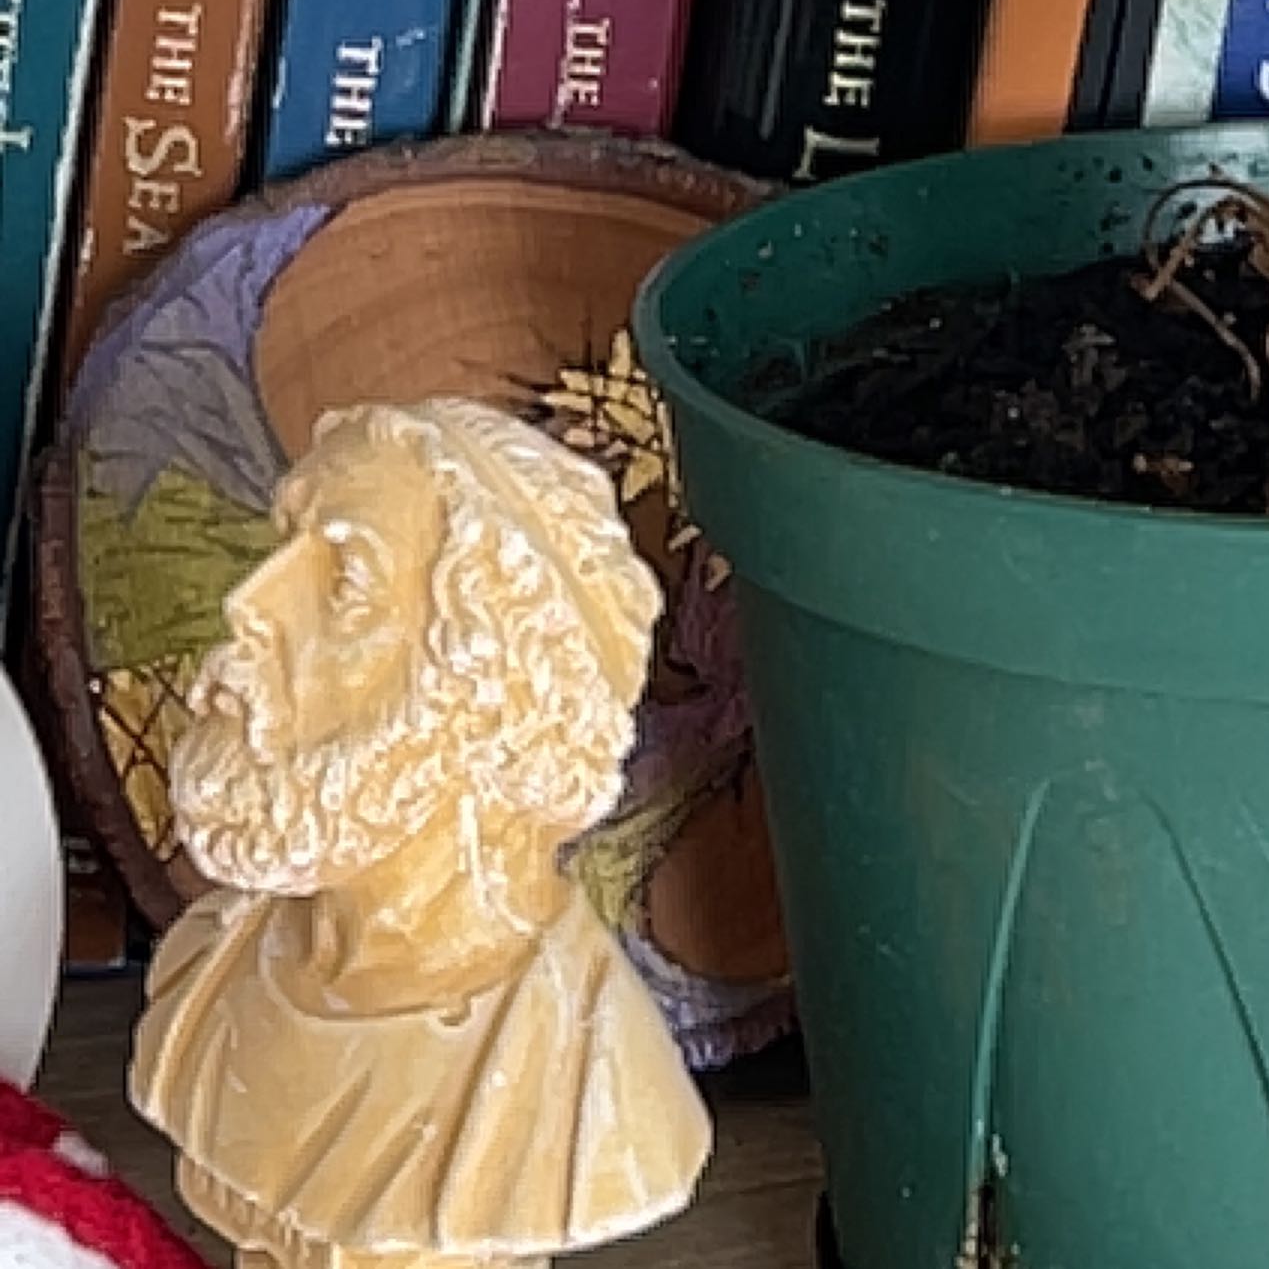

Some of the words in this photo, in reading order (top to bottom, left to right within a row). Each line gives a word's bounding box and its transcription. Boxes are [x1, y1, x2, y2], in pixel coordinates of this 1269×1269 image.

[145, 3, 204, 106] THE
[325, 36, 384, 148] THE
[556, 16, 610, 108] THE
[121, 115, 203, 257] SEA
